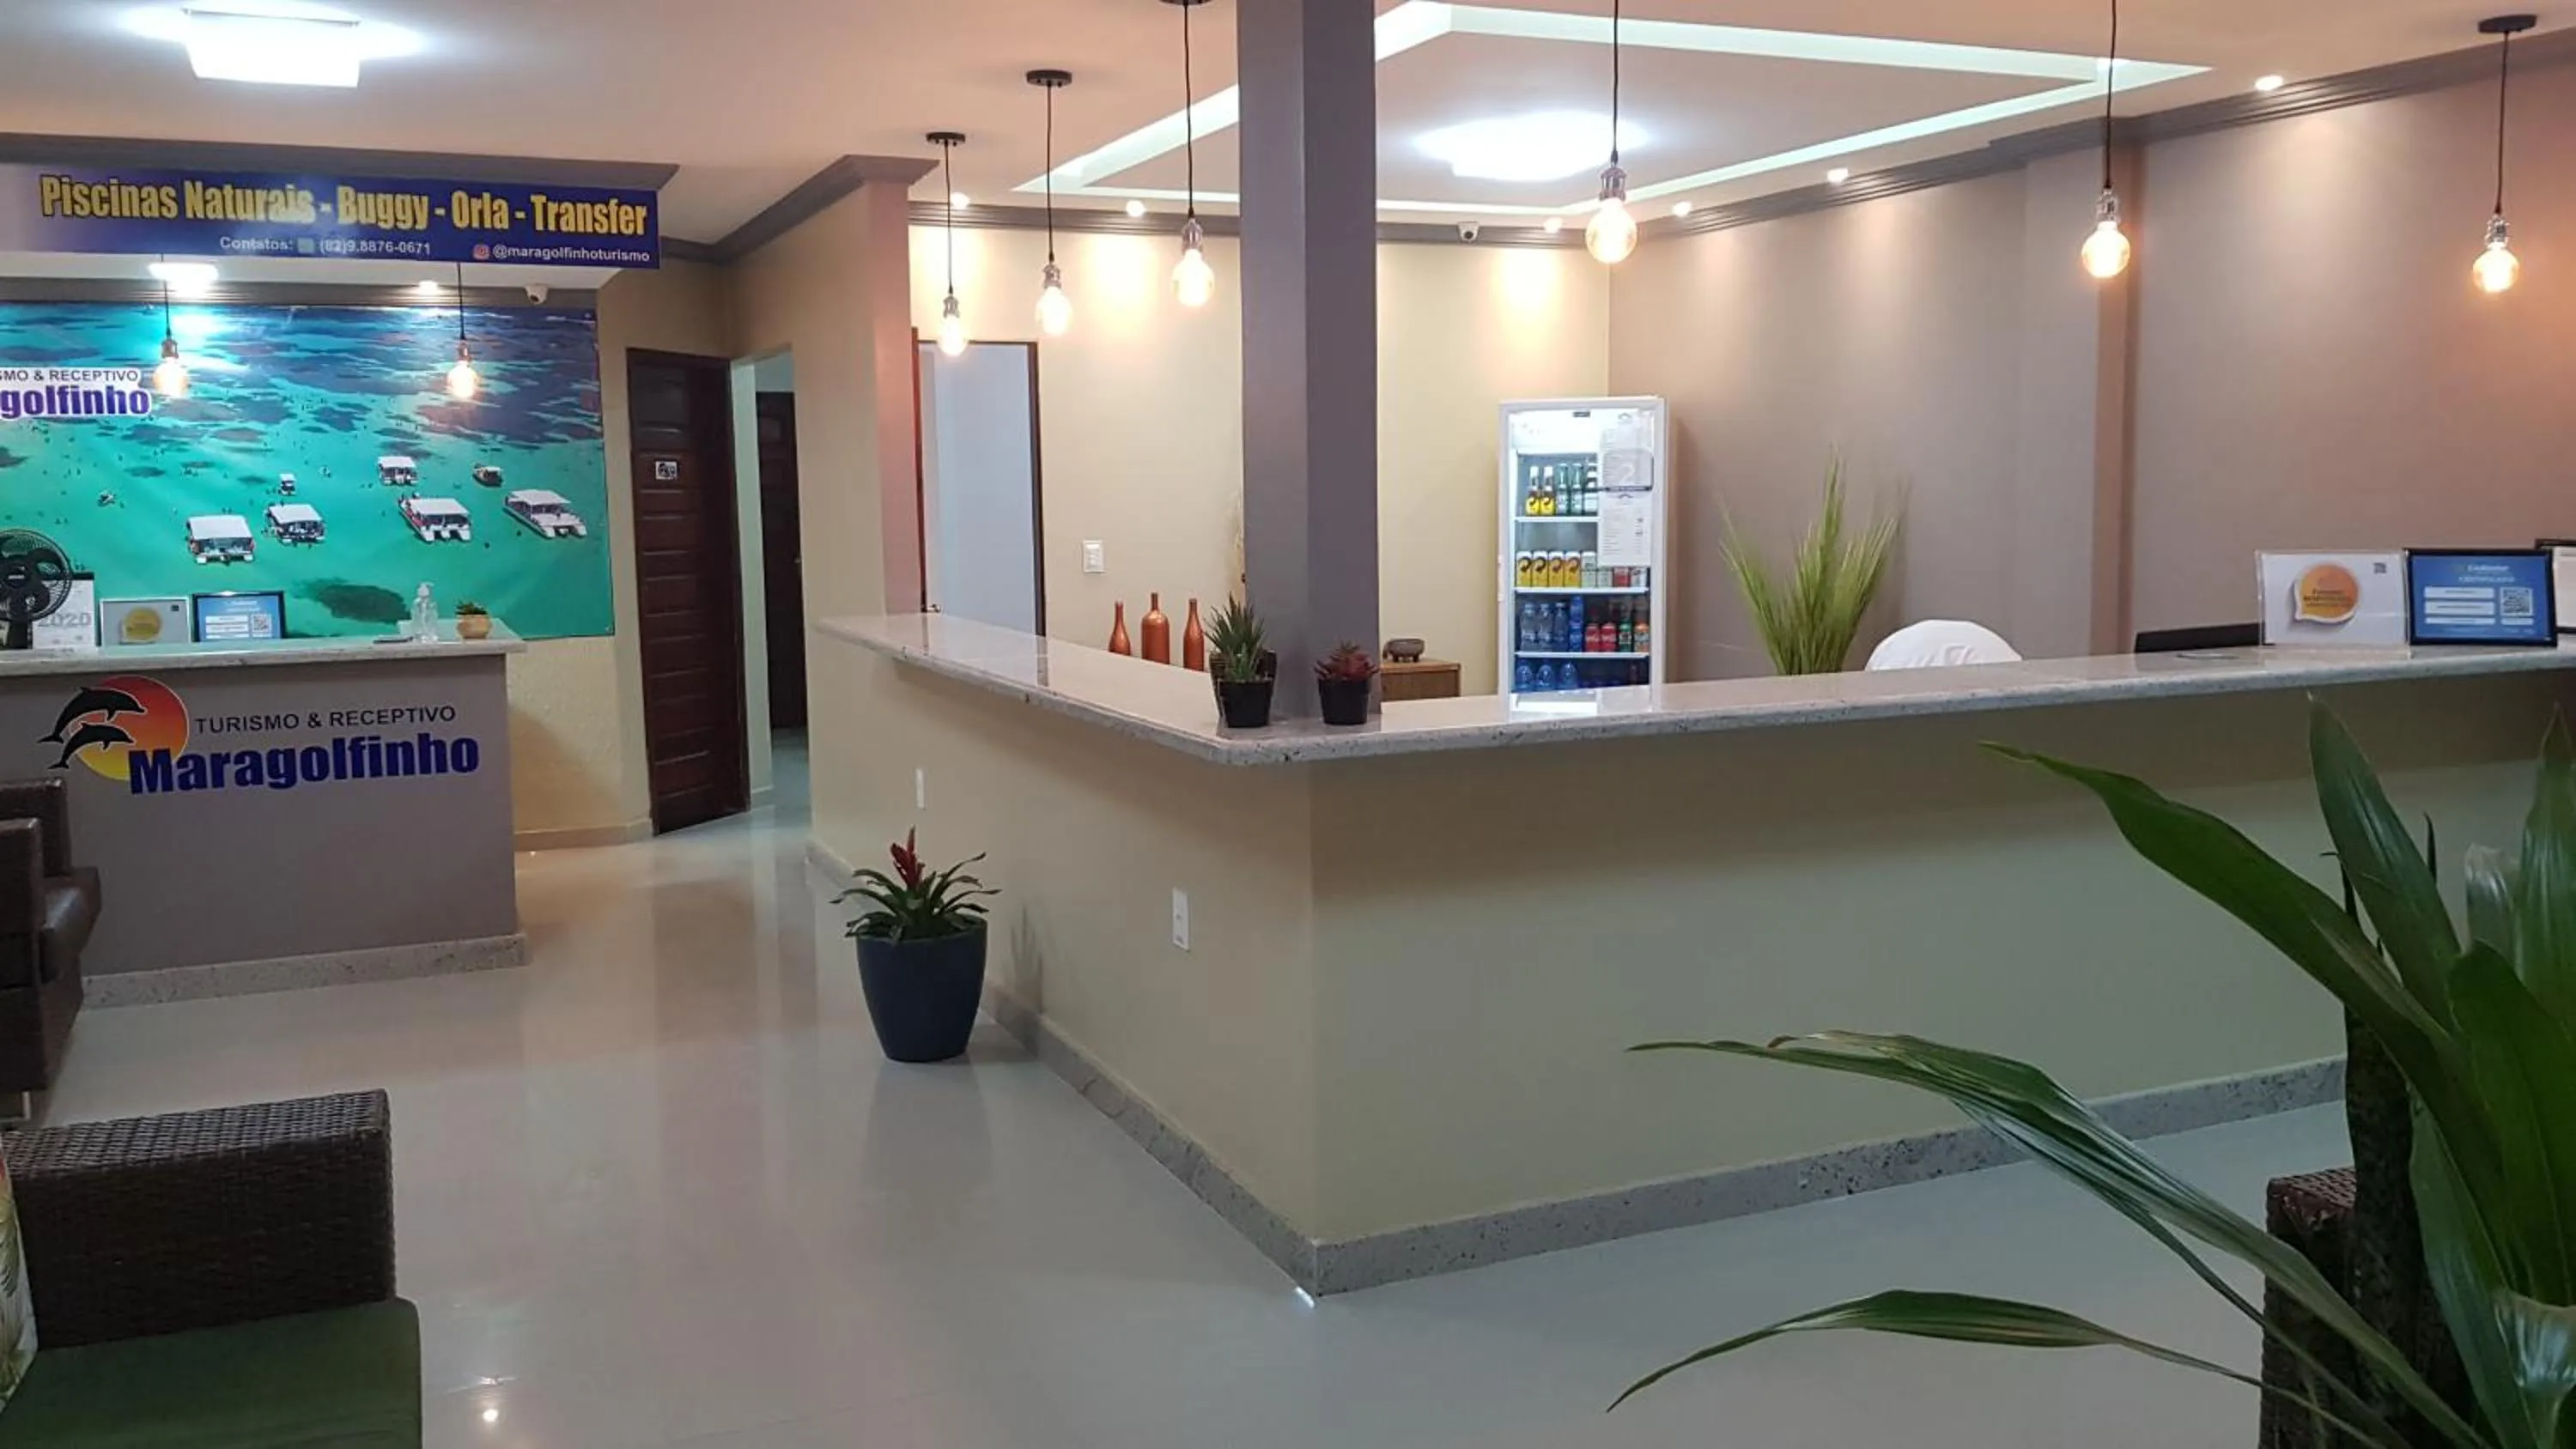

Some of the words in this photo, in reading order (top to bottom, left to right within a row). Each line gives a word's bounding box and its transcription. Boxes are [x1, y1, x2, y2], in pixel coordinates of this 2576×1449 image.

[40, 174, 178, 219] Piscinas
[184, 179, 316, 224] Naturais
[337, 185, 428, 230] Buggy
[451, 191, 510, 229] Orla
[530, 194, 647, 236] Transfer
[219, 236, 293, 251] Contatos:
[493, 245, 650, 263] @maragolfinhoturismo
[0, 370, 28, 382] MO
[33, 370, 45, 382] &
[49, 370, 138, 382] RECEPTIVO
[196, 712, 300, 733] TURISMO
[307, 712, 323, 728] &
[330, 705, 457, 726] RECEPTIVO
[128, 732, 479, 794] Maragolfinho
